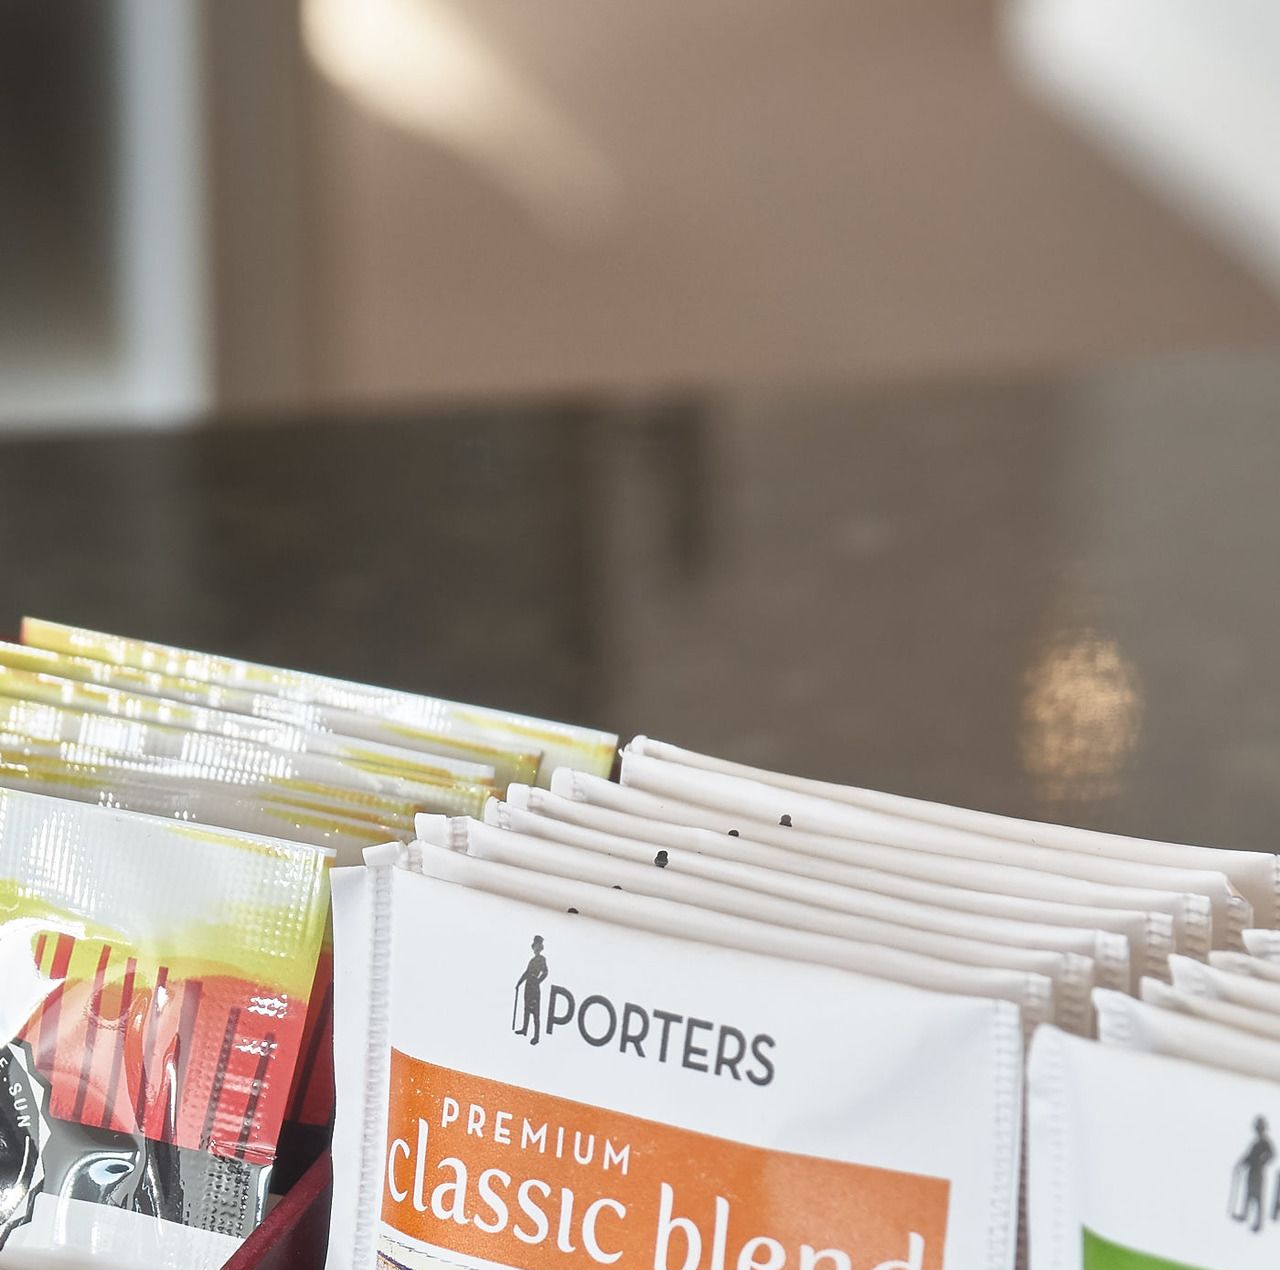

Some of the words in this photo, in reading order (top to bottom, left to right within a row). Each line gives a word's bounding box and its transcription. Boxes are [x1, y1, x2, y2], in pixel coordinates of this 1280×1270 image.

[546, 985, 777, 1086] PORTERS
[8, 1082, 32, 1128] SUN
[441, 1096, 632, 1177] PREMIUM
[386, 1119, 629, 1265] classic
